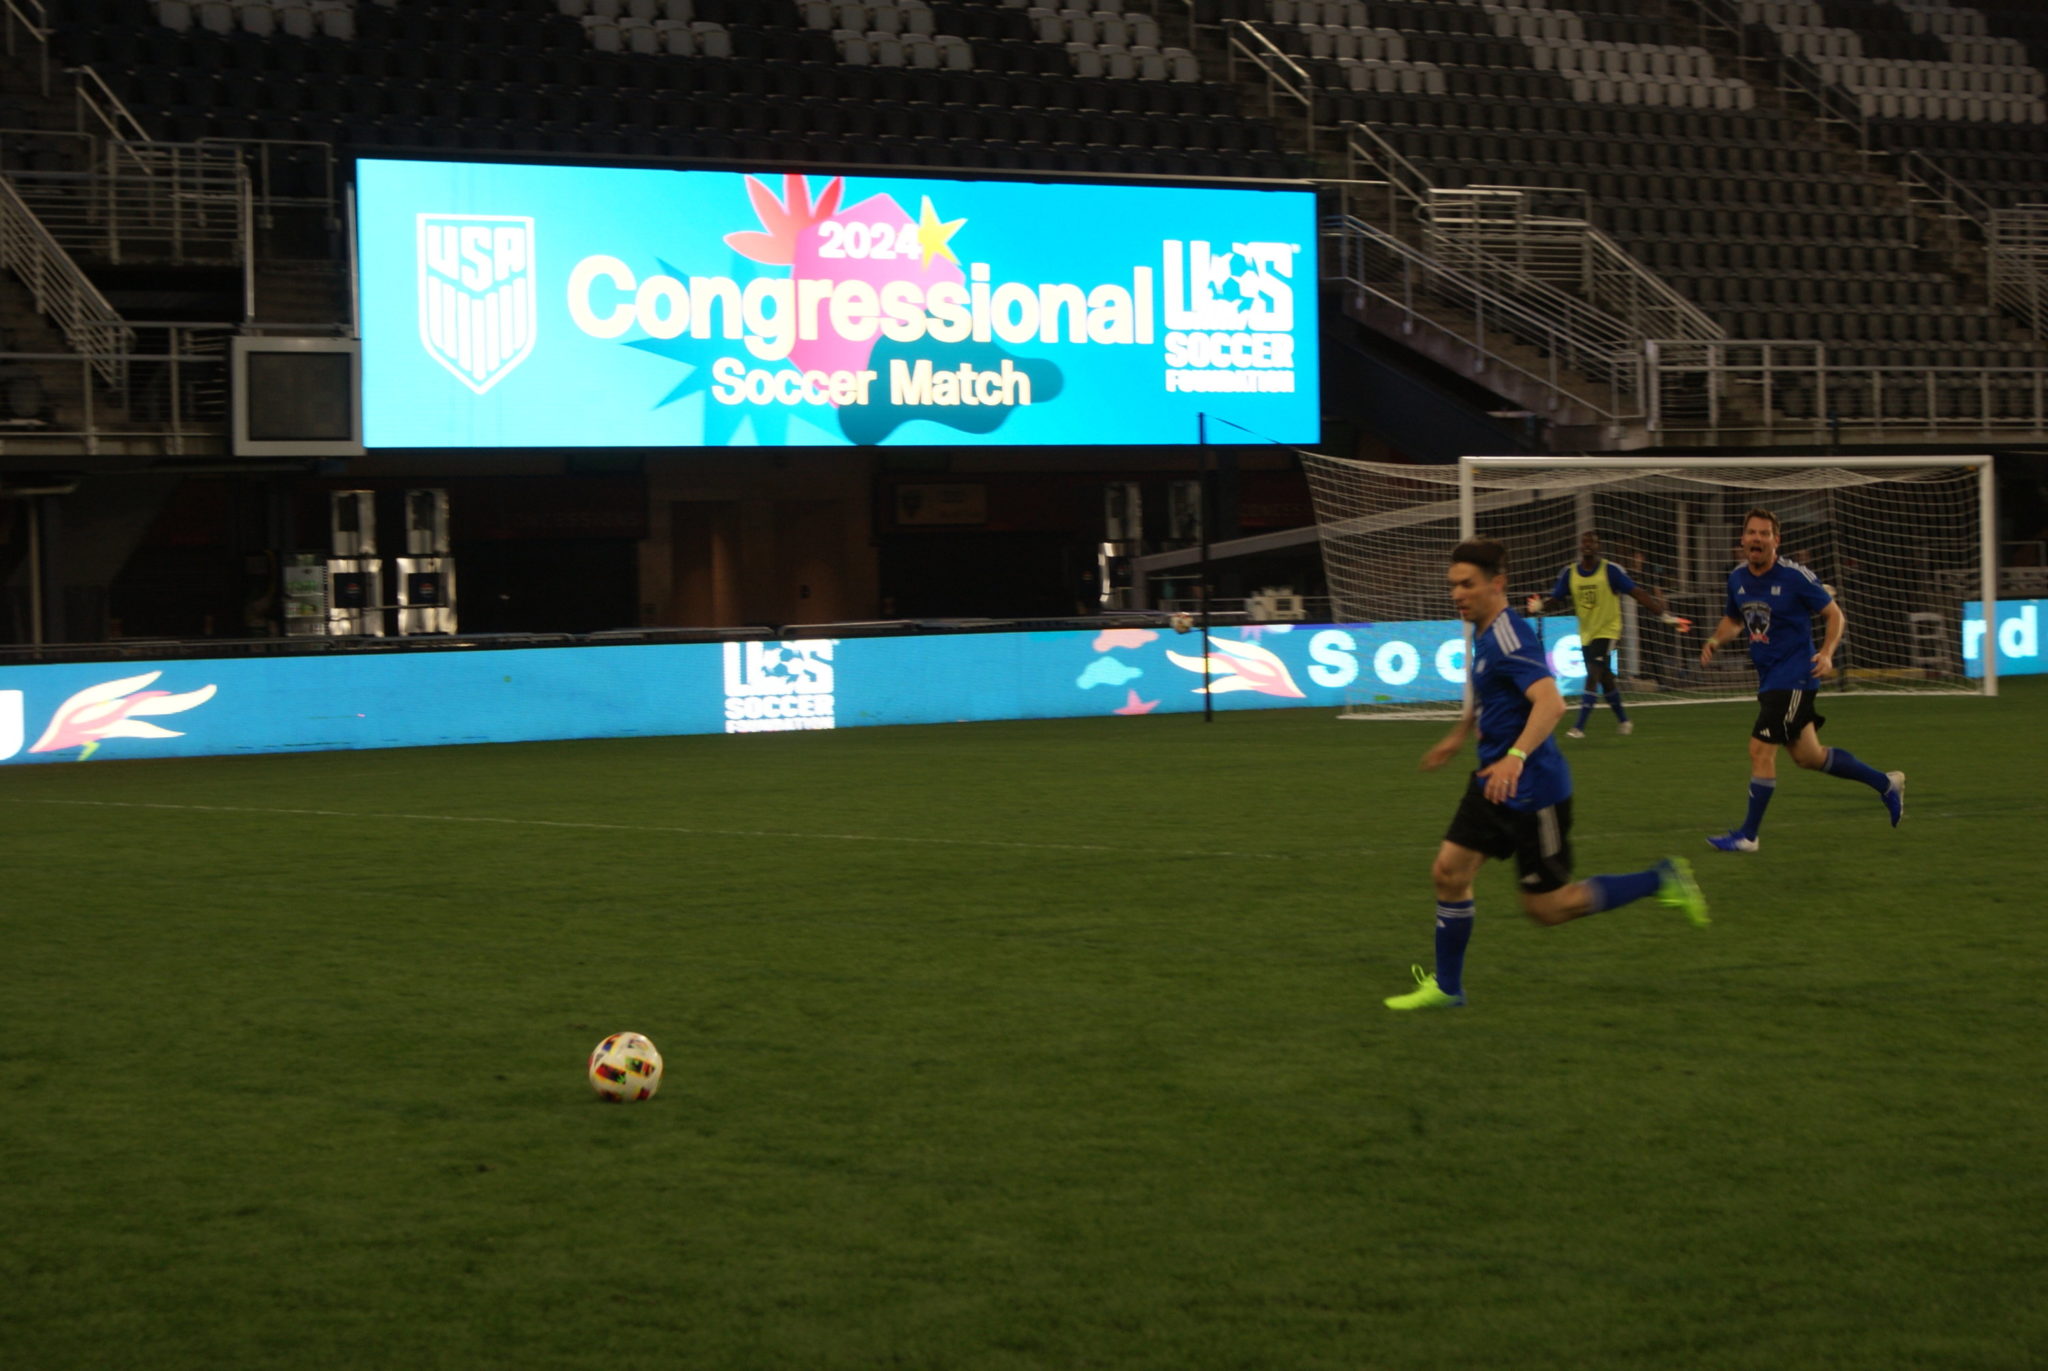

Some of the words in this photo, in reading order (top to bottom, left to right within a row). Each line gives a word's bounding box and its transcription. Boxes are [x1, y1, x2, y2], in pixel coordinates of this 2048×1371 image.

[426, 225, 526, 292] USA
[818, 220, 923, 260] 2024
[567, 254, 1154, 361] Congressional
[1164, 331, 1295, 368] SOCCER
[711, 357, 877, 407] Soccer
[889, 359, 1031, 406] Match
[724, 692, 836, 720] SOCCER
